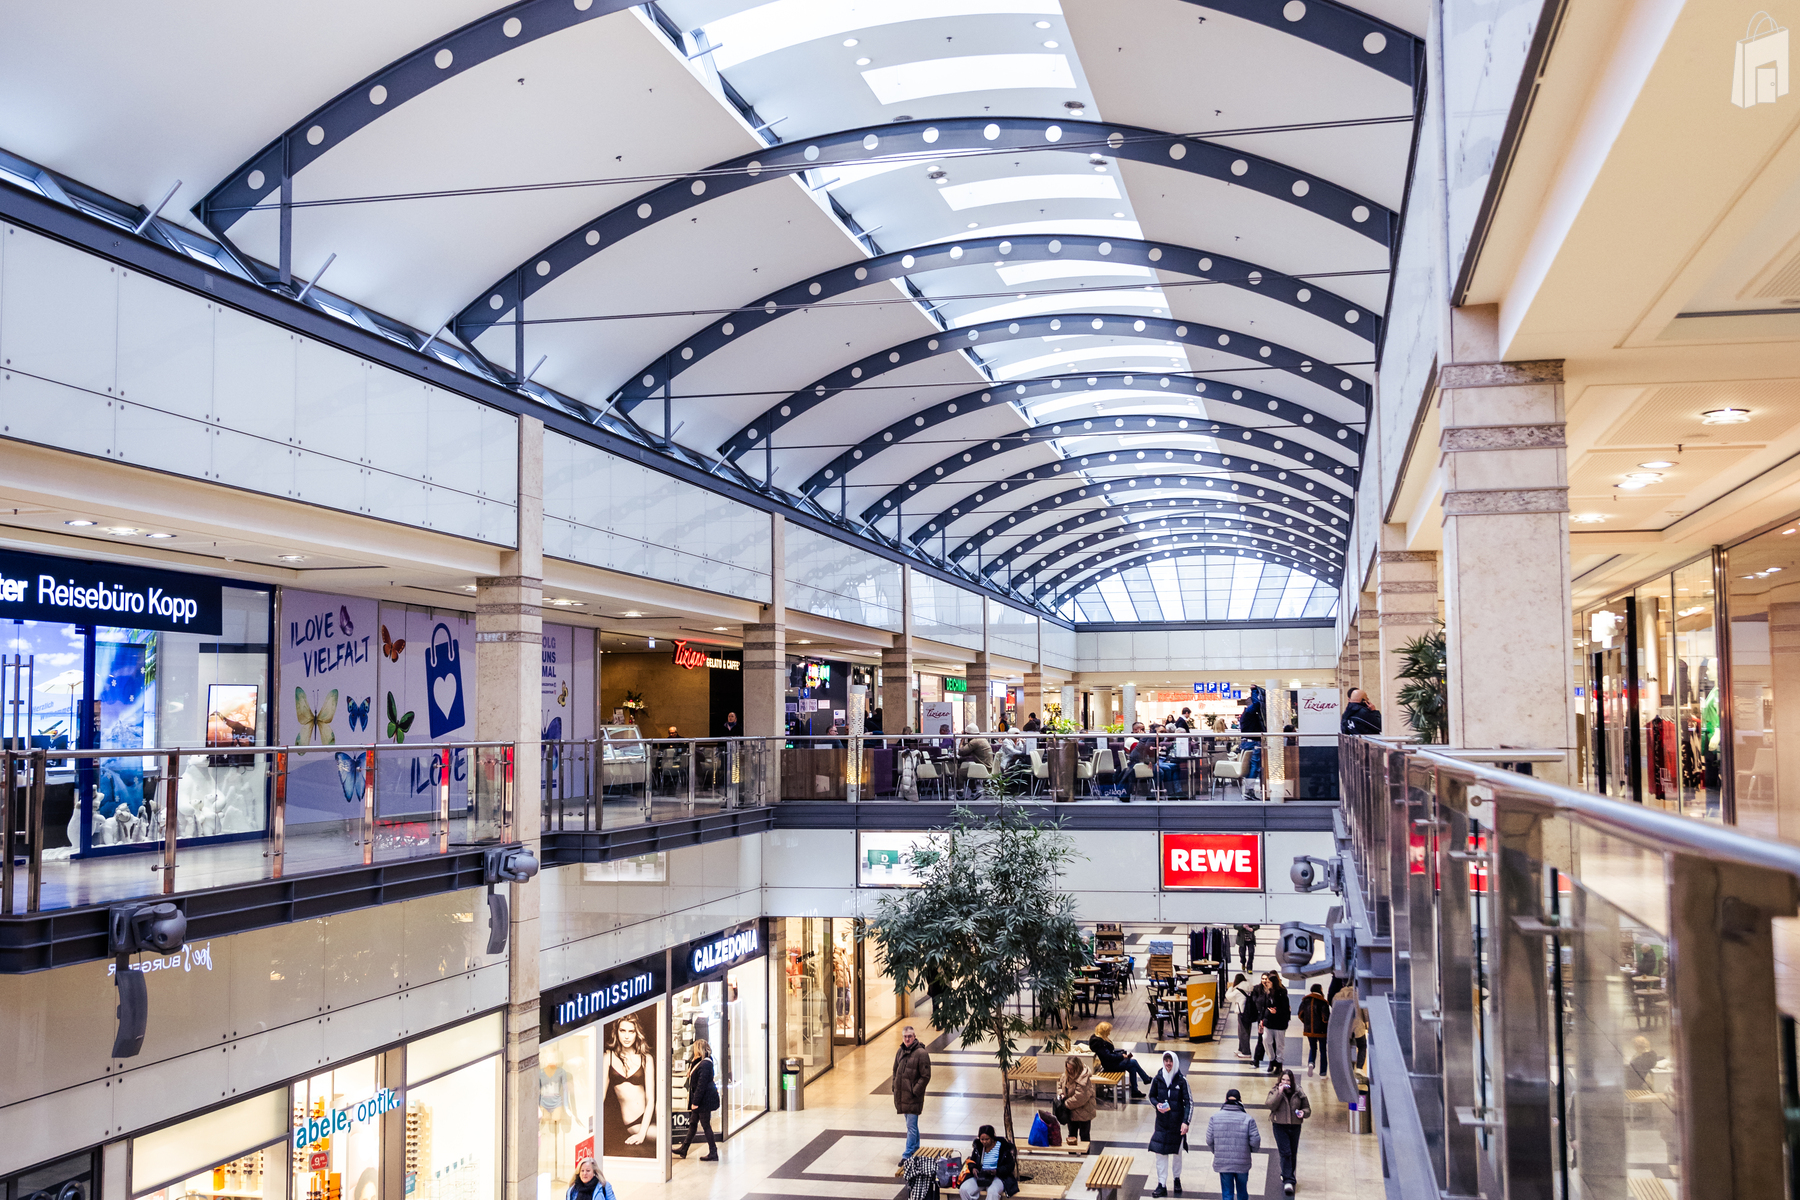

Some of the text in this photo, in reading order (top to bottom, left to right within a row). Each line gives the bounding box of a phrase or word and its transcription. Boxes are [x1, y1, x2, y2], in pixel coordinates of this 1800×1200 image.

[38, 574, 144, 614] Reisebüro
[148, 588, 198, 624] Kopp
[303, 636, 370, 678] VIELFALT
[542, 651, 556, 663] UNS
[674, 639, 708, 670] Tiziano
[705, 657, 722, 669] GELATO
[925, 708, 950, 719] Tiziano
[1302, 697, 1339, 711] Tiziano
[881, 854, 889, 863] D
[1171, 849, 1252, 873] REWE
[693, 928, 758, 973] CALZEDONIA
[558, 972, 653, 1026] intimissimi
[296, 1088, 400, 1149] abele, optik.
[672, 1114, 690, 1126] 10%
